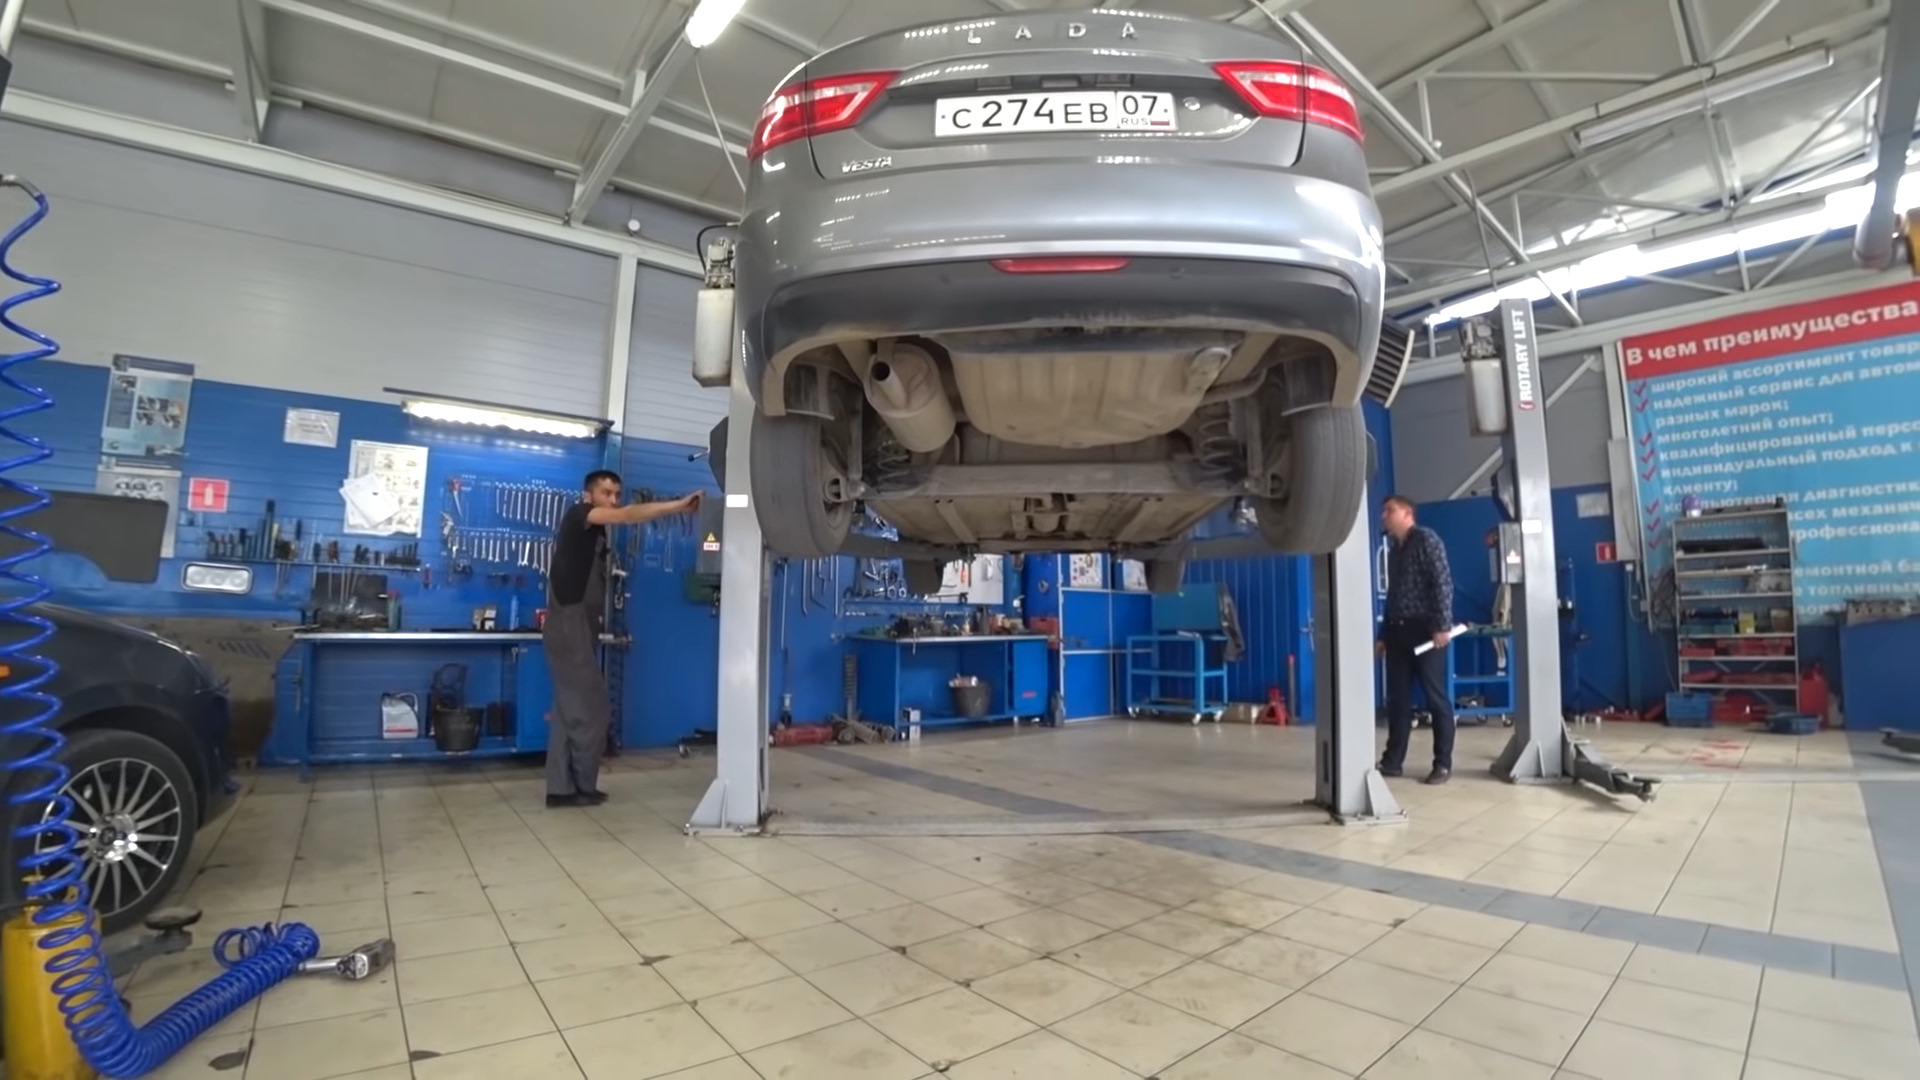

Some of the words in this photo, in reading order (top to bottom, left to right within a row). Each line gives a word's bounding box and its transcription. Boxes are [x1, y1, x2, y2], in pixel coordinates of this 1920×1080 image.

[967, 22, 1138, 44] LADA
[1122, 95, 1158, 115] 07
[1121, 117, 1148, 126] RUS
[842, 156, 892, 173] VESTA
[1511, 309, 1527, 339] LIFT
[1626, 347, 1643, 366] В
[1647, 341, 1697, 361] чем
[1702, 300, 1919, 354] преимущества
[1514, 343, 1533, 401] ROTARY
[1651, 369, 1728, 393] широкий
[1732, 351, 1854, 381] ассортимент
[1748, 376, 1814, 396] сервис
[1818, 370, 1854, 387] для
[1655, 409, 1720, 430] разных
[1657, 416, 1773, 445] многолетний
[1660, 424, 1857, 462] квалифицированный
[1661, 449, 1817, 479] индивидуальный
[1821, 443, 1897, 462] подход
[1787, 508, 1827, 521] сех
